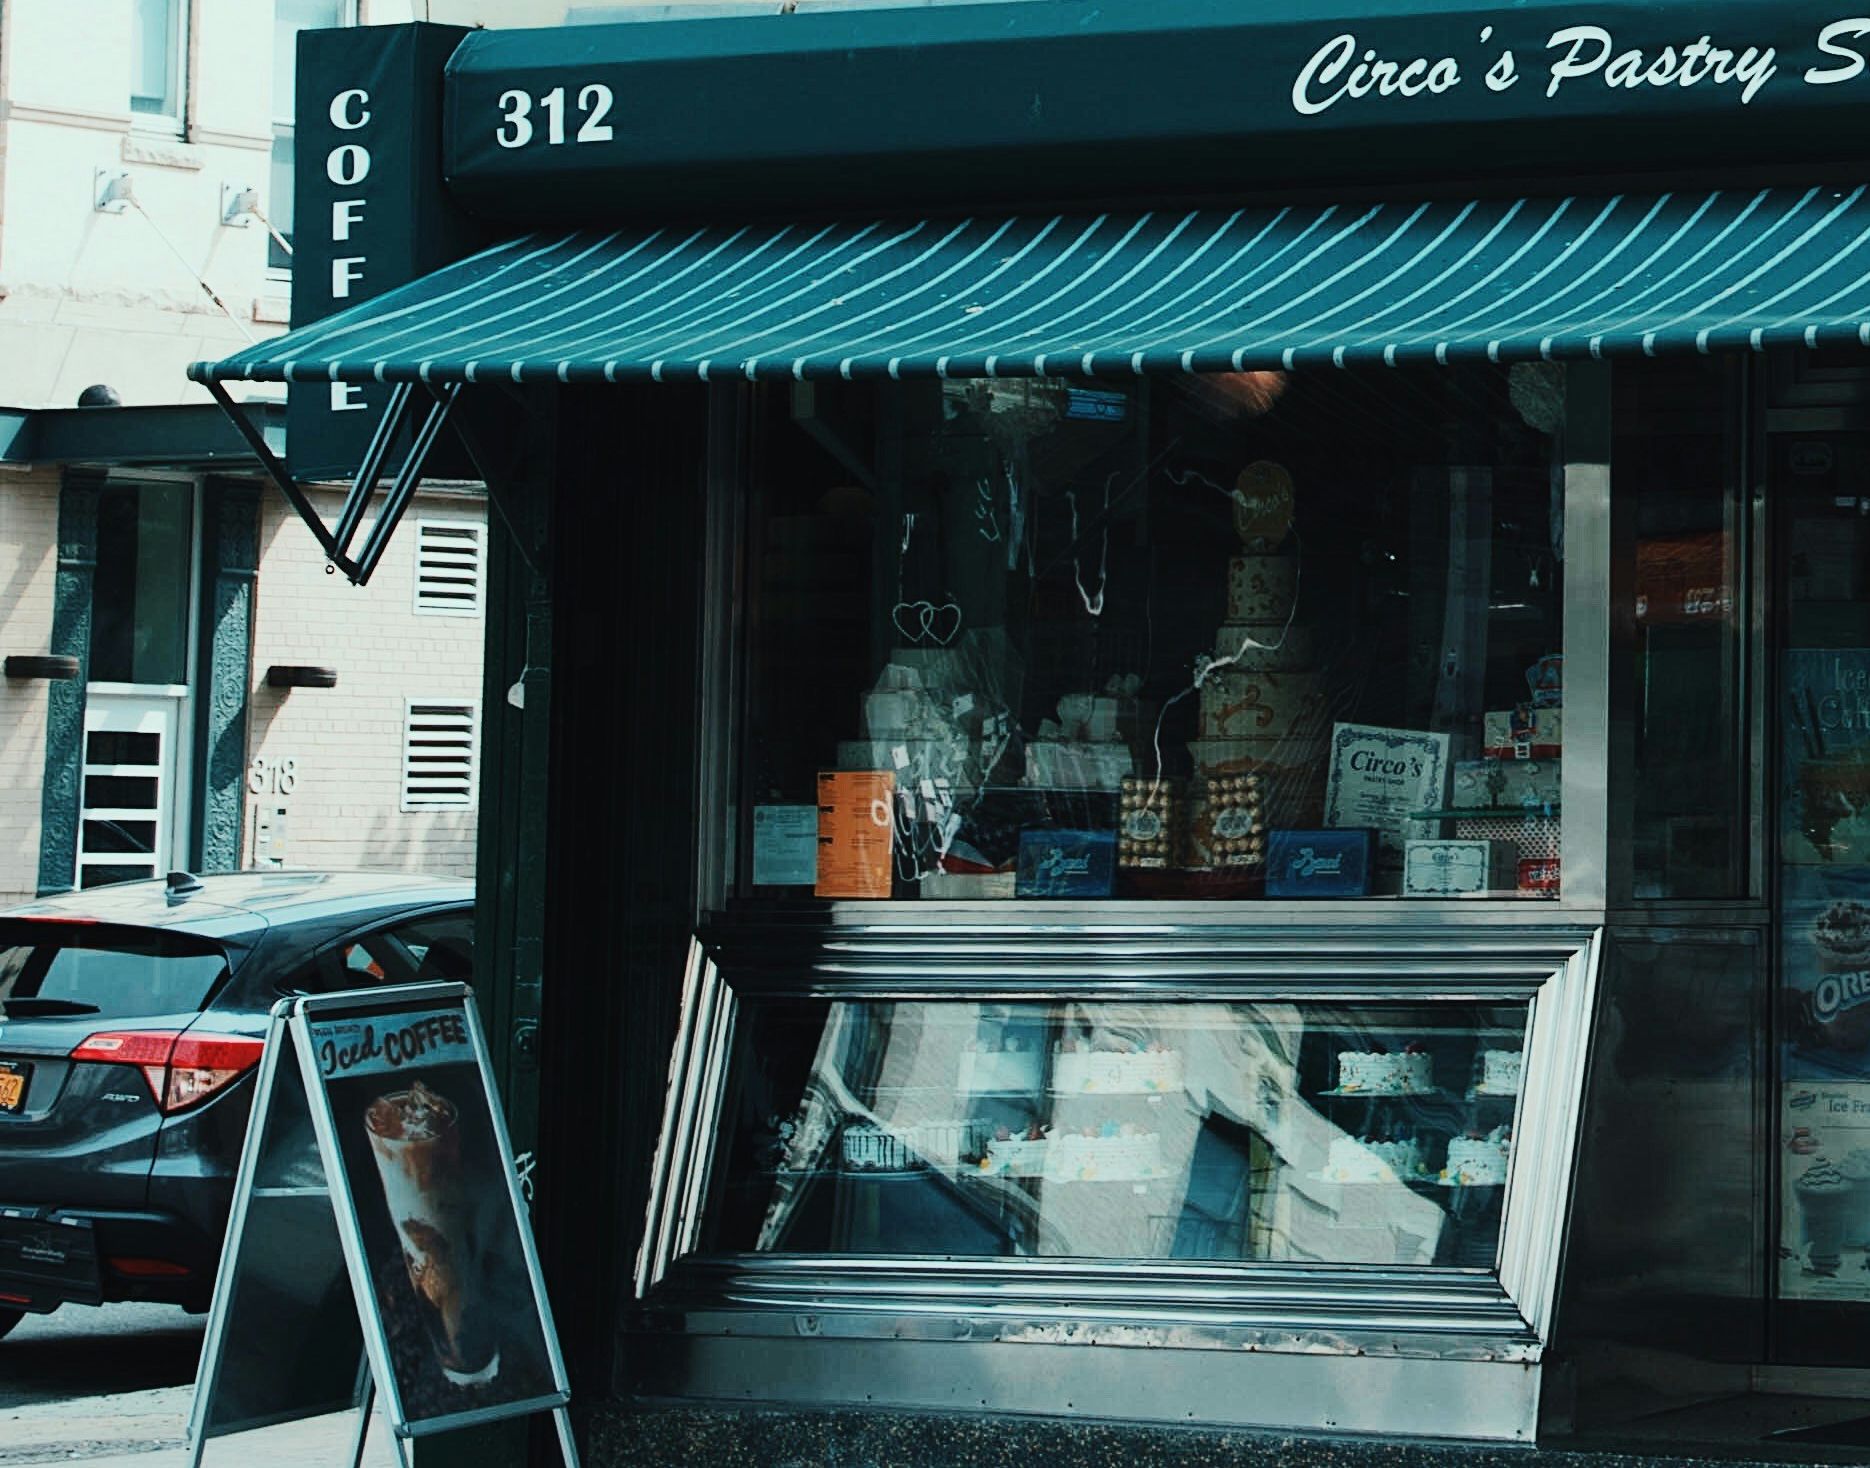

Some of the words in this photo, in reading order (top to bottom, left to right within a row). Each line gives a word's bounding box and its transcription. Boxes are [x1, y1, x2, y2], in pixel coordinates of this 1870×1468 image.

[1291, 25, 1520, 115] Circo's
[1545, 25, 1777, 105] Pastry
[495, 82, 615, 150] 312
[327, 89, 371, 411] COFFE
[248, 754, 297, 795] 318
[1350, 749, 1424, 778] Circo's
[321, 1024, 383, 1076] Iced
[384, 1014, 469, 1066] COFFEE
[1828, 1099, 1849, 1113] Ice
